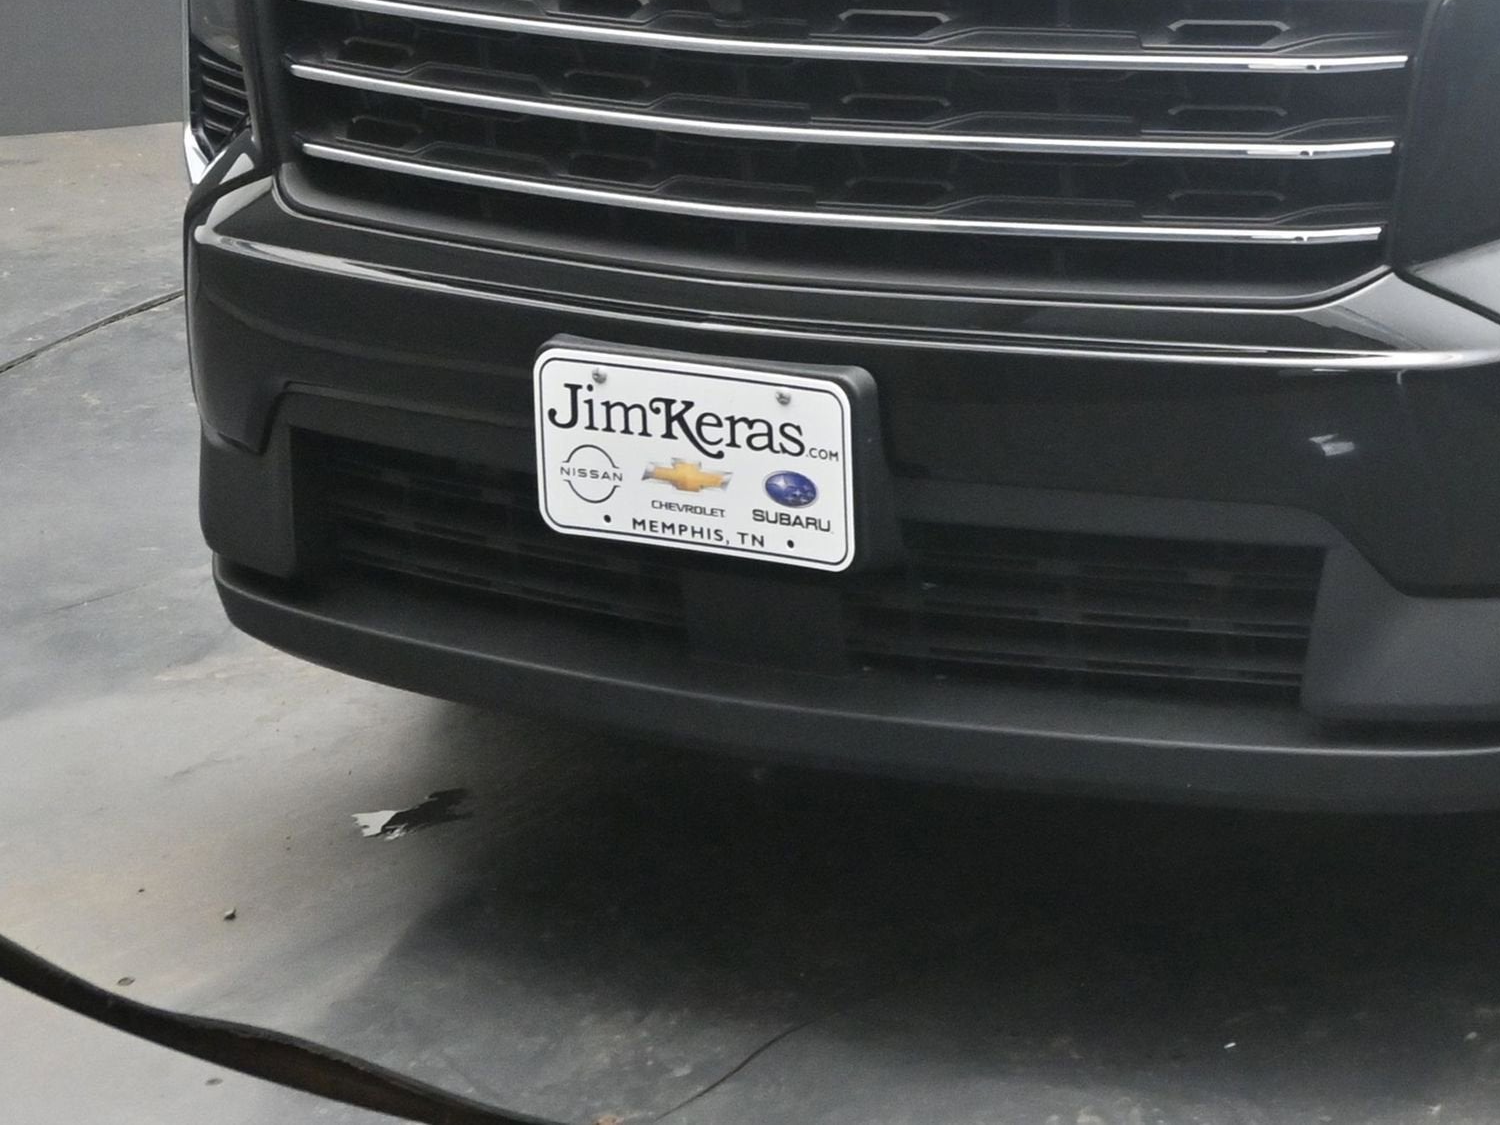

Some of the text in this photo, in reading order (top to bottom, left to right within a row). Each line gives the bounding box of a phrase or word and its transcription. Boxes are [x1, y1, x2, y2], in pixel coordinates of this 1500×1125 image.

[559, 465, 624, 482] NISSAN
[650, 499, 726, 518] CHEVROLET
[751, 507, 832, 533] SUBARU
[631, 517, 766, 548] MEMPHIS, TN
